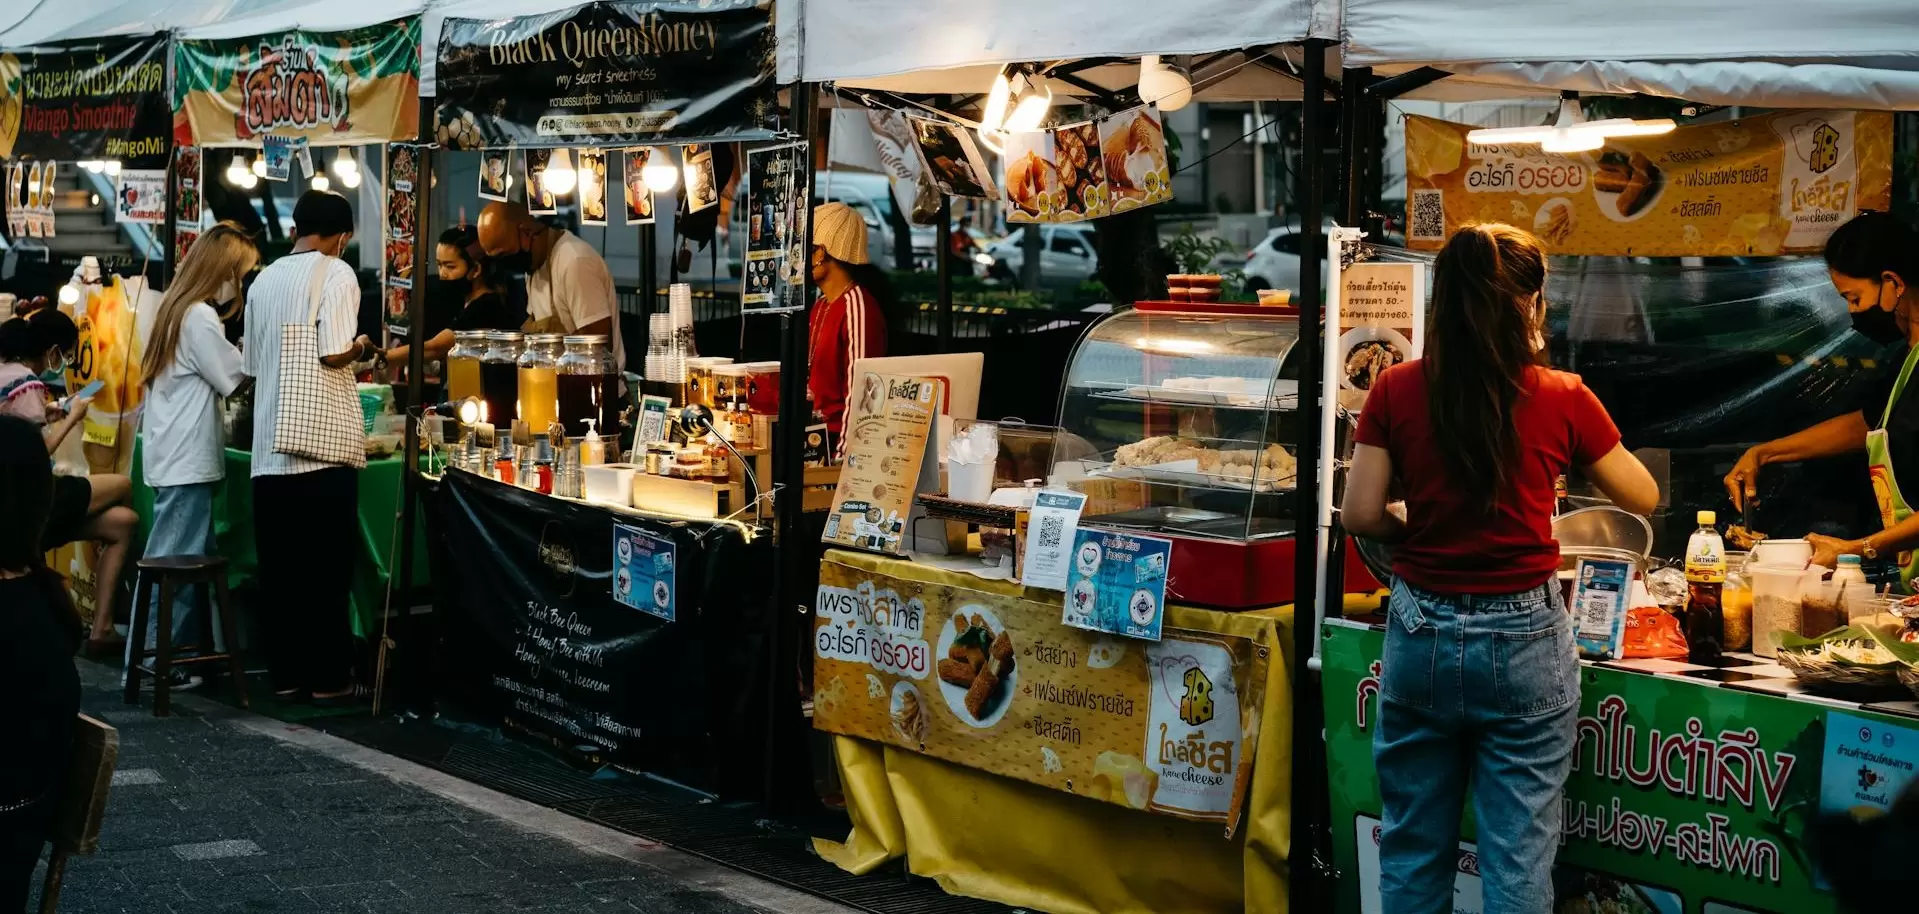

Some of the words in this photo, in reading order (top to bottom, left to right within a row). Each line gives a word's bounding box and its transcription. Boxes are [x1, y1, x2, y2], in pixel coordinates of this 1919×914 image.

[489, 25, 557, 66] Black
[556, 74, 572, 90] my
[24, 104, 69, 138] Mango
[72, 99, 136, 131] Smoothie
[1469, 163, 1515, 188] อะไรก็
[1810, 208, 1840, 223] cheese
[567, 612, 592, 637] Queen
[819, 624, 867, 656] อะไรก็
[871, 633, 925, 672] อร่อย
[1034, 640, 1076, 668] ชีสย่าง
[1159, 723, 1234, 775] ใกล้ชีส
[1181, 766, 1225, 786] cheese
